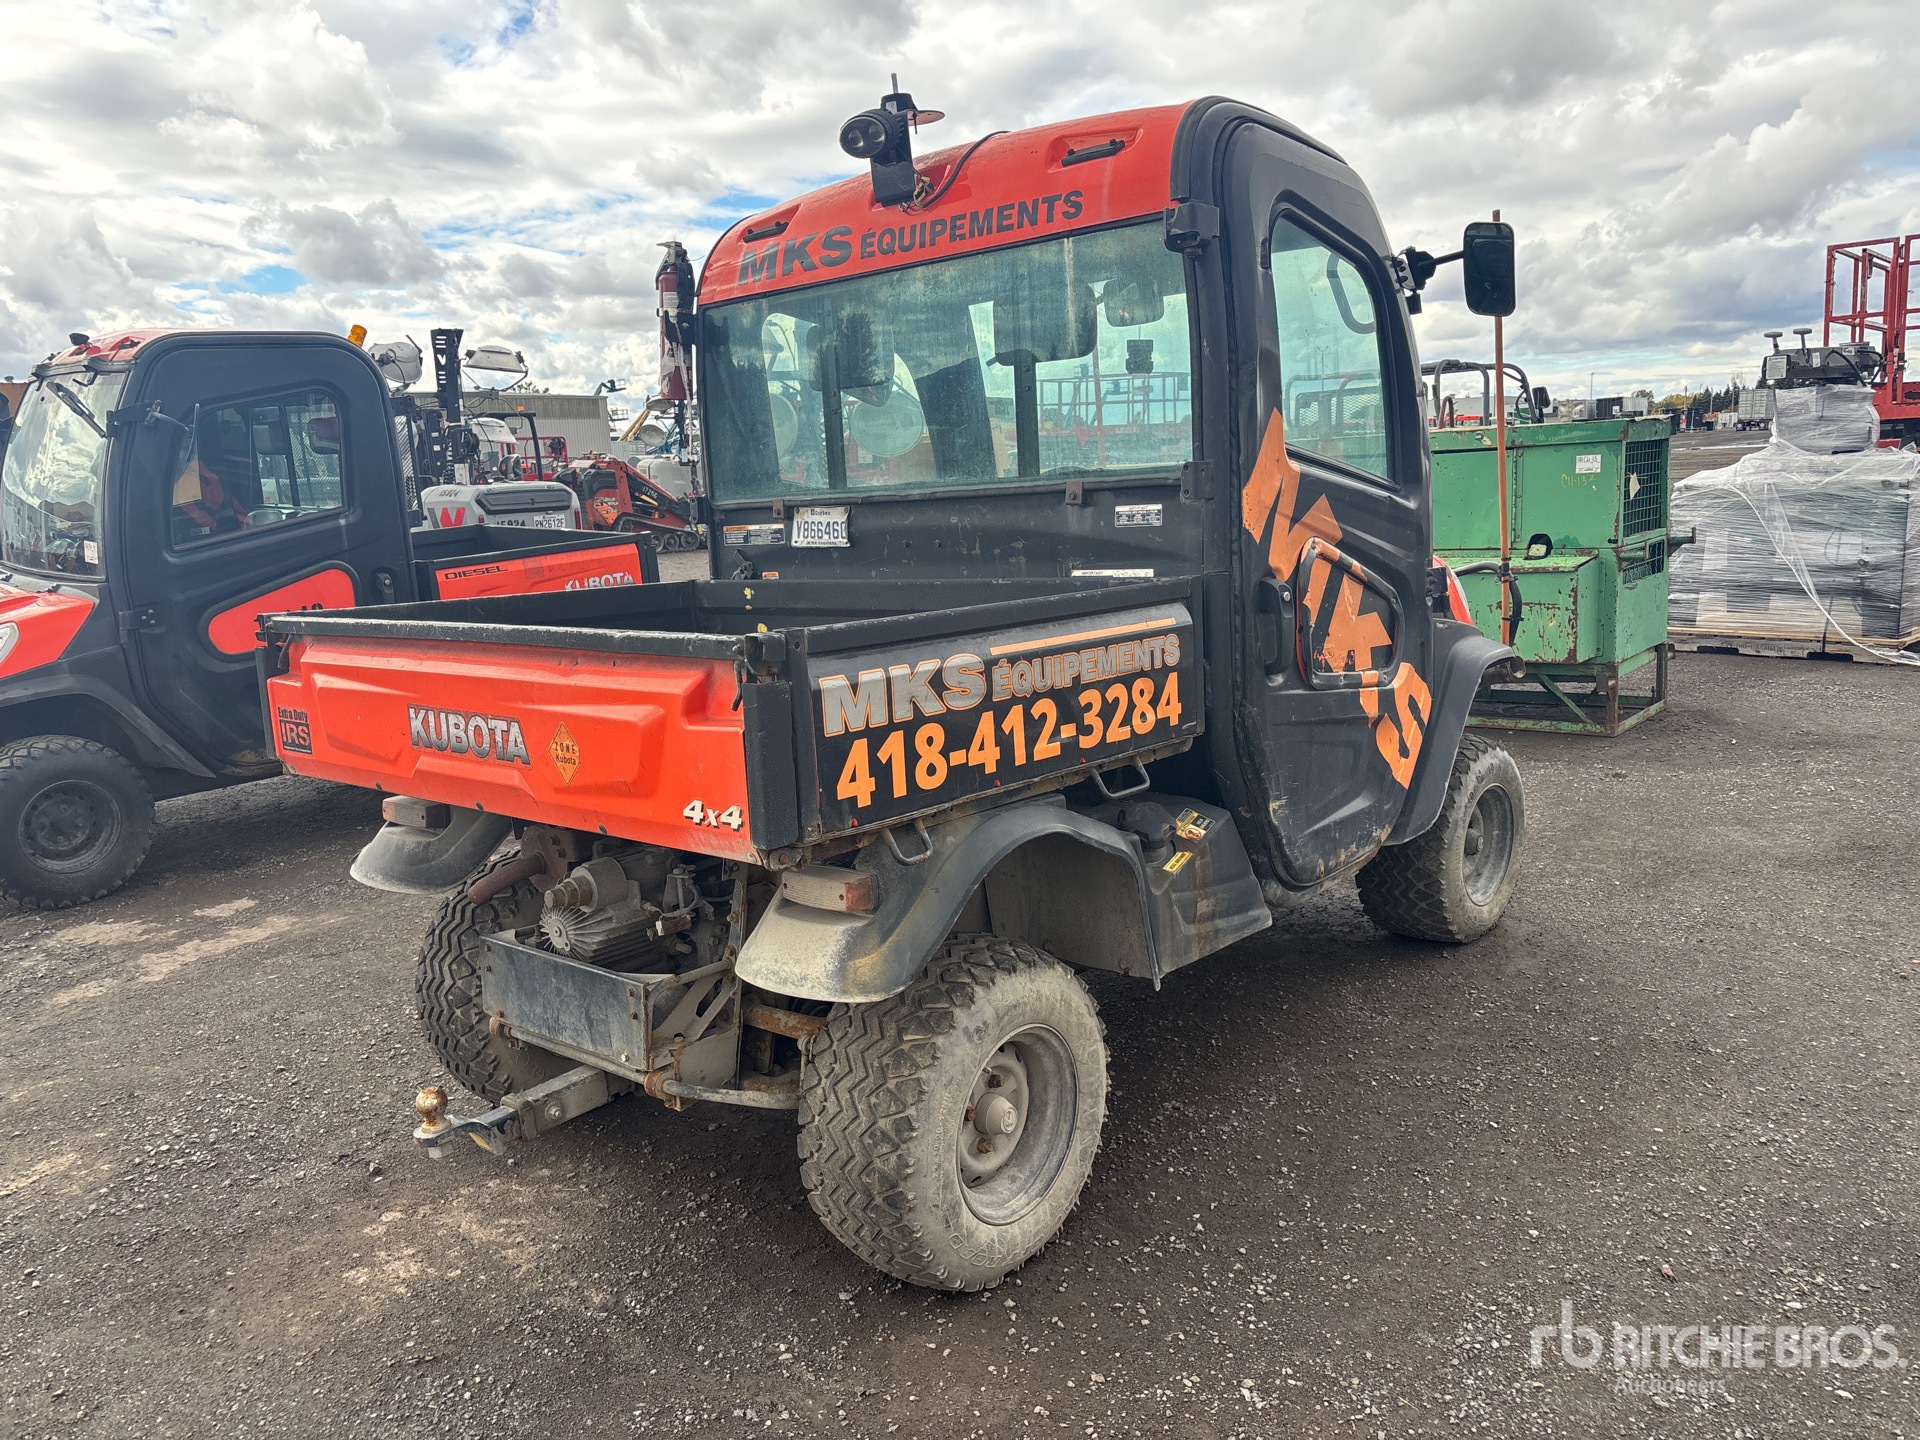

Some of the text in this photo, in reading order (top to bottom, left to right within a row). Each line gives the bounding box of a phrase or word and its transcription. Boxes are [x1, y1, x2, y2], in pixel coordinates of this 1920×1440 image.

[738, 190, 1084, 287] MKS ÉQUIPEMENTS
[444, 565, 508, 580] DIESEL
[564, 572, 635, 591] KUBOTA
[1242, 407, 1432, 789] MKS
[818, 633, 1181, 738] MKS ÉQUIPEMENTS
[281, 721, 311, 747] IRS
[407, 706, 531, 766] KUBOTA
[555, 754, 577, 766] Kubota
[836, 671, 1183, 809] 418-412-3284
